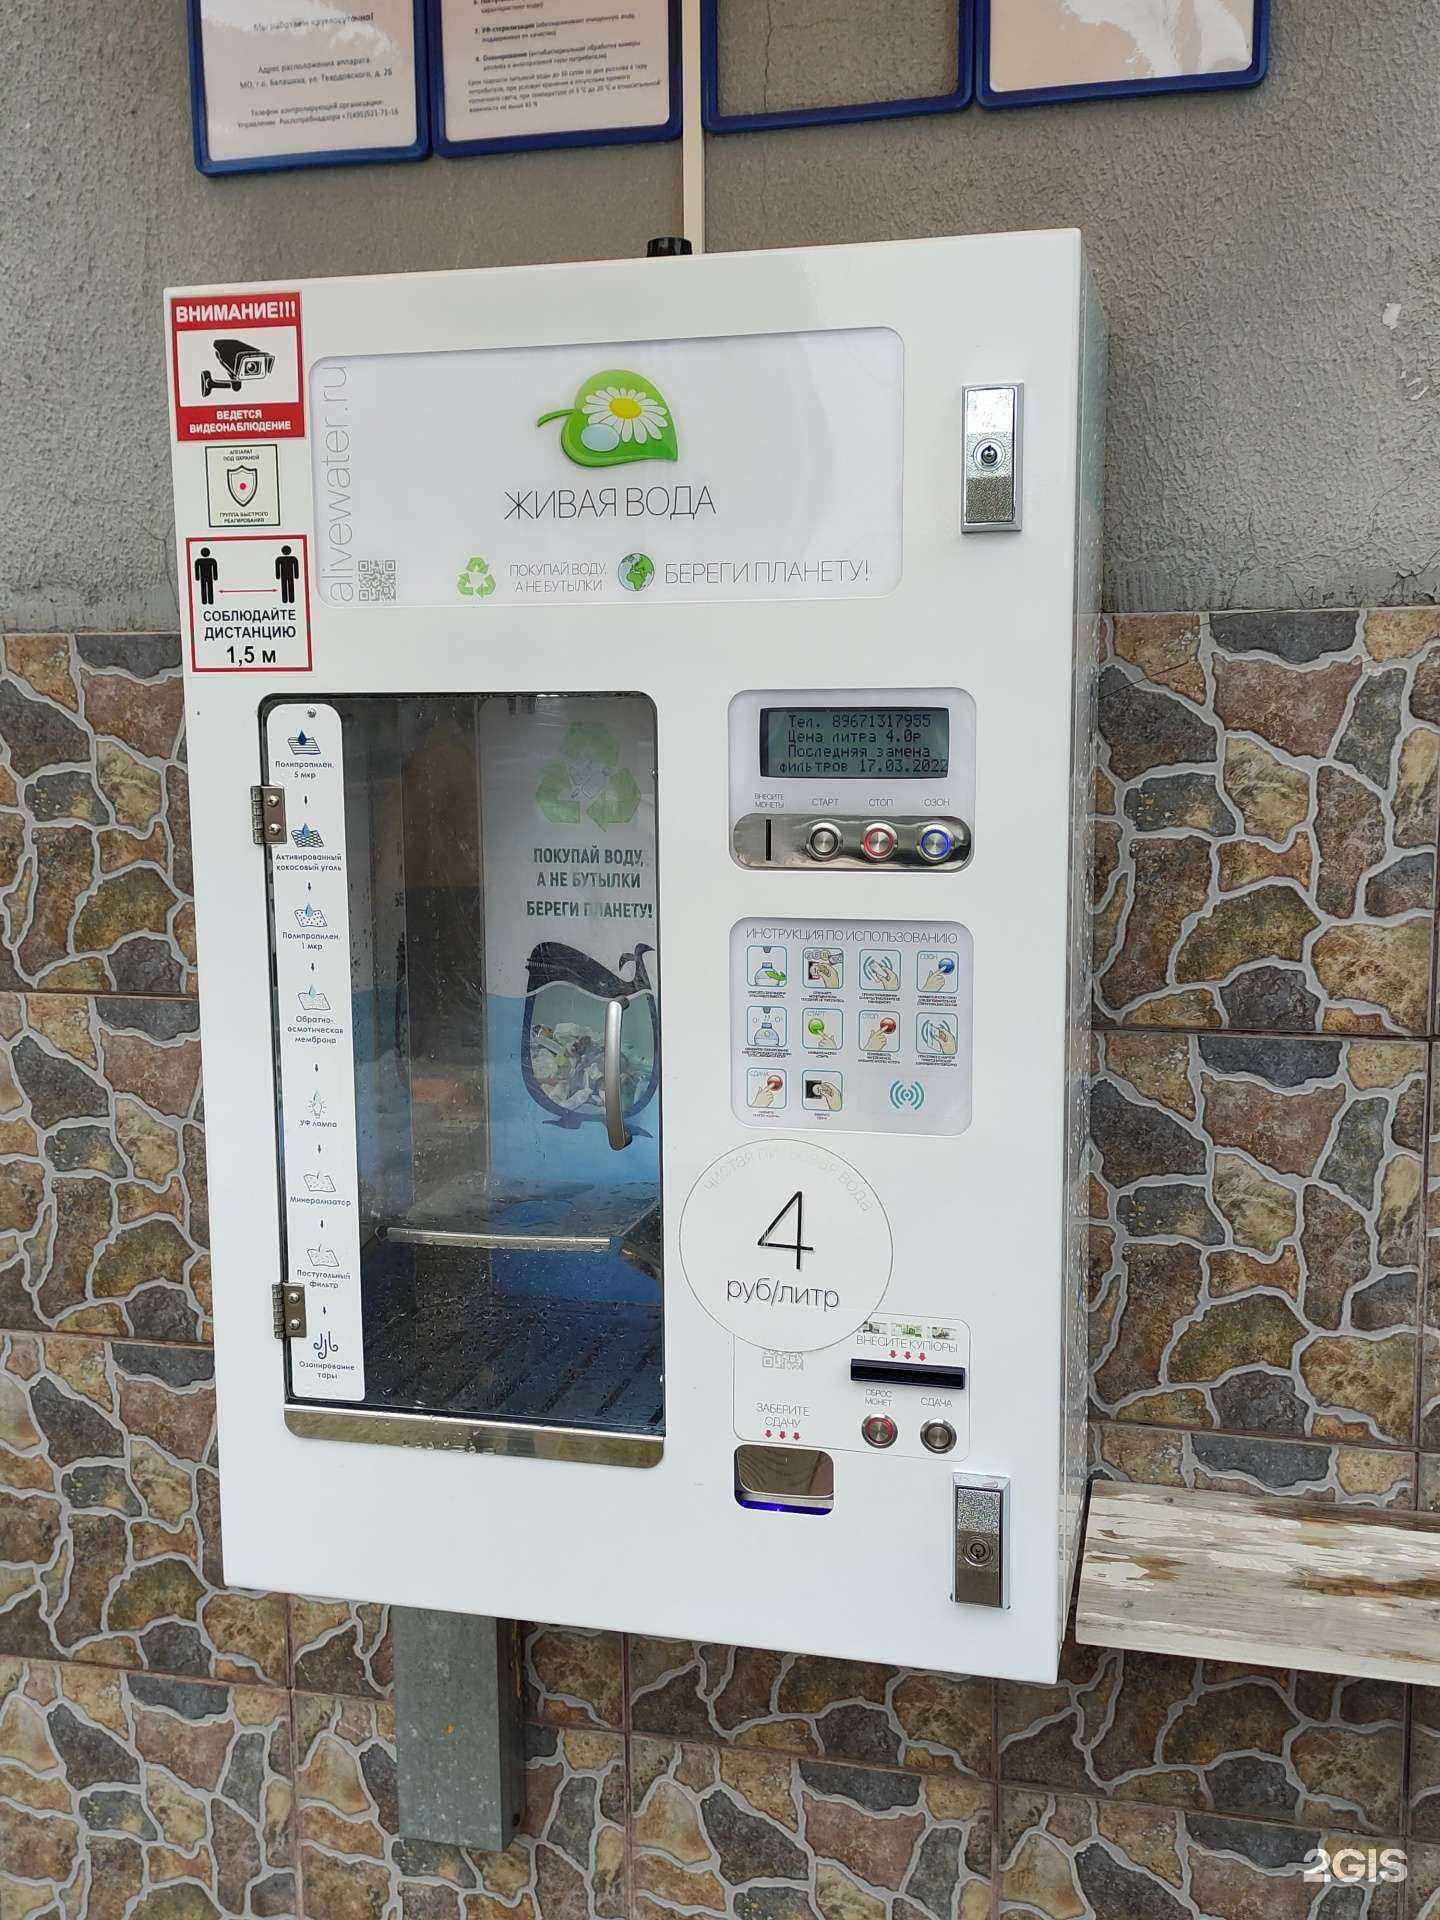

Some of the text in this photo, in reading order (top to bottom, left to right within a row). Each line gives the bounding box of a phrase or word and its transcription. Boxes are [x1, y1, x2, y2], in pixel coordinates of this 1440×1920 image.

[176, 301, 295, 323] ВНИМАНИЕ!!!
[216, 409, 263, 421] ВЕДЕТСЯ
[189, 420, 293, 435] ВИДЕОНАБЛЮДЕНИЕ
[320, 366, 354, 602] alivewater.ru
[504, 484, 715, 521] ЖИВАЯ ВОДА
[509, 561, 570, 577] ПОКУПАЙ
[665, 559, 871, 585] БЕРЕГИ ПЛАНЕТУ!
[515, 579, 604, 592] А НЕ БУТЫЛКИ
[203, 606, 297, 623] СОБЛЮДАЙТЕ
[204, 626, 297, 642] ДИСТАНЦИЮ
[227, 645, 277, 667] 1,5 м
[789, 713, 933, 729] Тел. 89671317955
[788, 730, 823, 745] Цена
[832, 732, 877, 743] литра
[788, 745, 931, 759] Последняя замена
[779, 762, 849, 774] фильтров
[811, 797, 950, 807] СТАРТ СТОП ОЗОН
[275, 853, 342, 862] Активированный
[533, 844, 644, 867] ПОКУПАЙ ВОДУ,
[276, 863, 342, 873] кокосовый уголь
[536, 872, 641, 889] А НЕ БУТЫЛКИ
[526, 900, 579, 918] БЕРЕГИ
[746, 927, 958, 944] ИНСТРУКЦИЯ ПО ИСПОЛЬЗОВАНИЮ
[757, 1190, 815, 1270] 4
[727, 1277, 840, 1312] руб/литр
[856, 1333, 958, 1353] ВНЕСИТЕ КУПЮРЫ
[756, 1401, 811, 1417] ЗАБЕРИТЕ
[920, 1396, 953, 1409] СДАЧА
[764, 1415, 801, 1429] СДАЧУ
